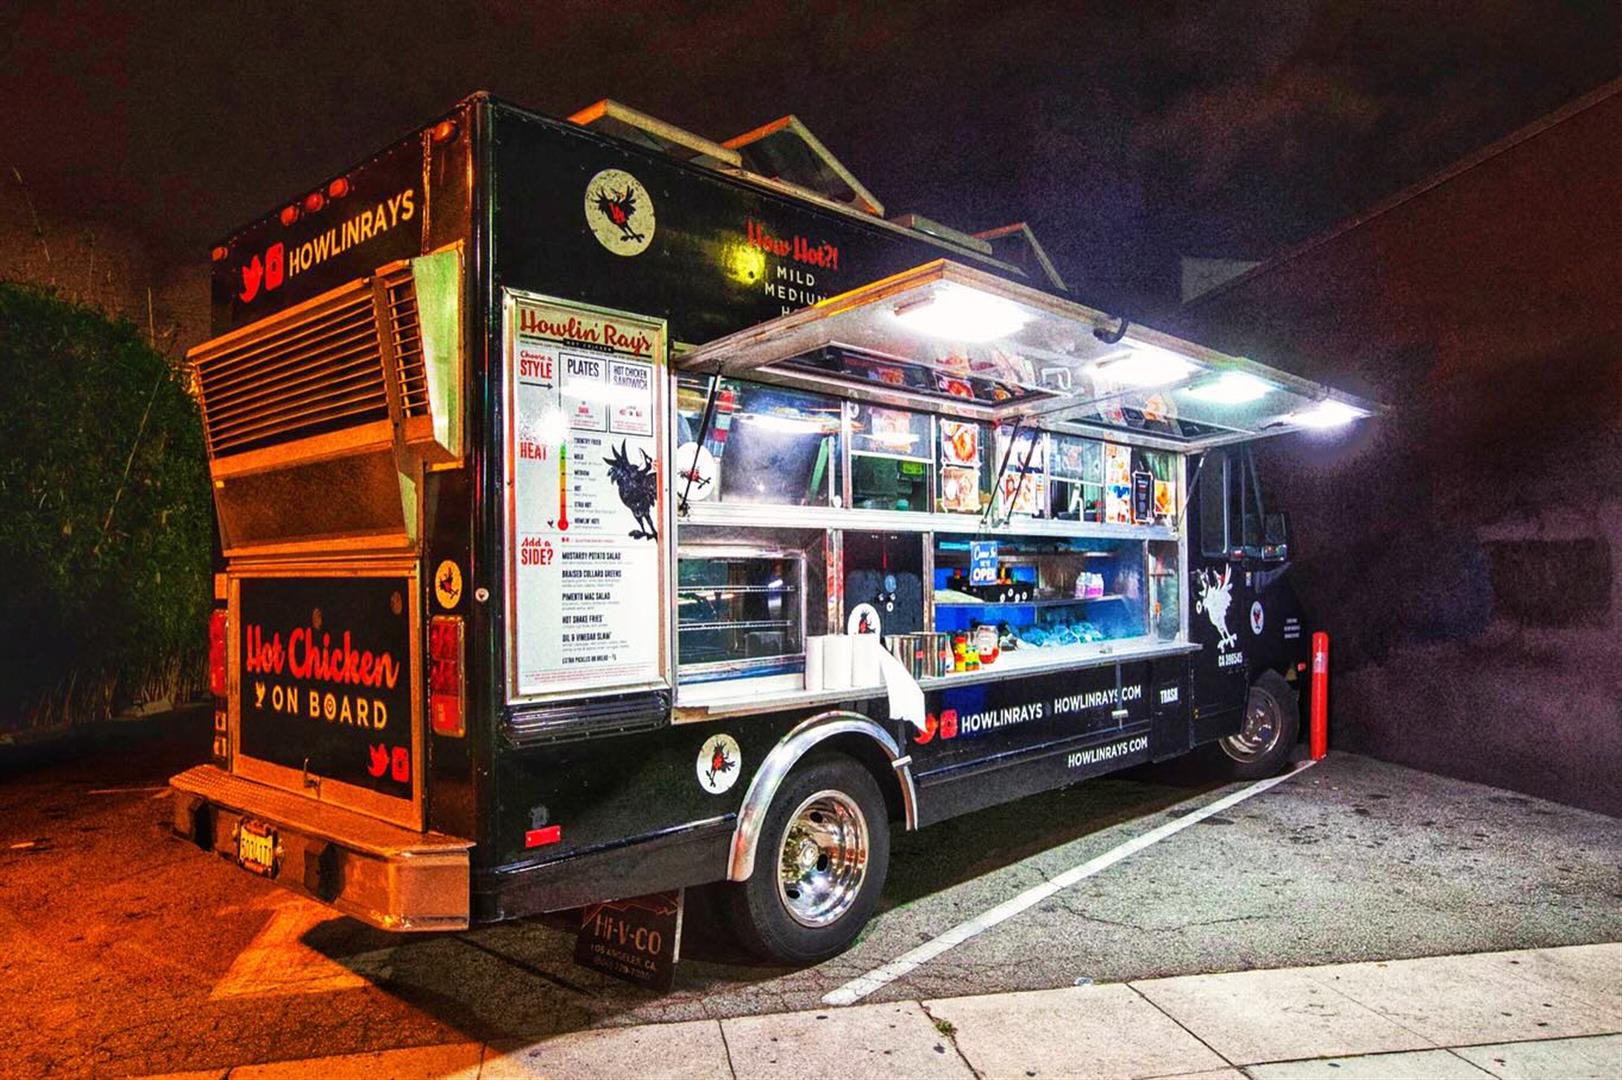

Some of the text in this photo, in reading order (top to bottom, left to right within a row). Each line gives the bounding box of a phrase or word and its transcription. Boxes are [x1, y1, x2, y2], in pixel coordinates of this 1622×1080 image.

[289, 188, 415, 277] HOWLINRAYS
[747, 218, 791, 257] How
[777, 265, 816, 287] MILD
[765, 282, 827, 305] MEDIU
[604, 323, 652, 357] Ray's
[520, 360, 553, 380] STYLE
[567, 358, 600, 377] PLATES
[614, 365, 647, 378] HOT CHICKEN
[521, 536, 541, 547] Add
[521, 548, 554, 565] SIDE?
[588, 551, 605, 560] POTATO
[562, 570, 582, 578] BRAISED
[604, 570, 622, 578] GREENS
[973, 568, 997, 581] OPEN
[562, 592, 610, 601] PIMENTO MAC SALAD
[562, 615, 572, 624] HOT
[562, 634, 570, 642] OIL
[576, 632, 596, 641] VINEGAR
[246, 623, 400, 689] Hot Chicken
[1159, 687, 1179, 704] TRASH
[272, 684, 388, 730] ON BOARD
[961, 703, 1043, 734] HOWLINRAYS
